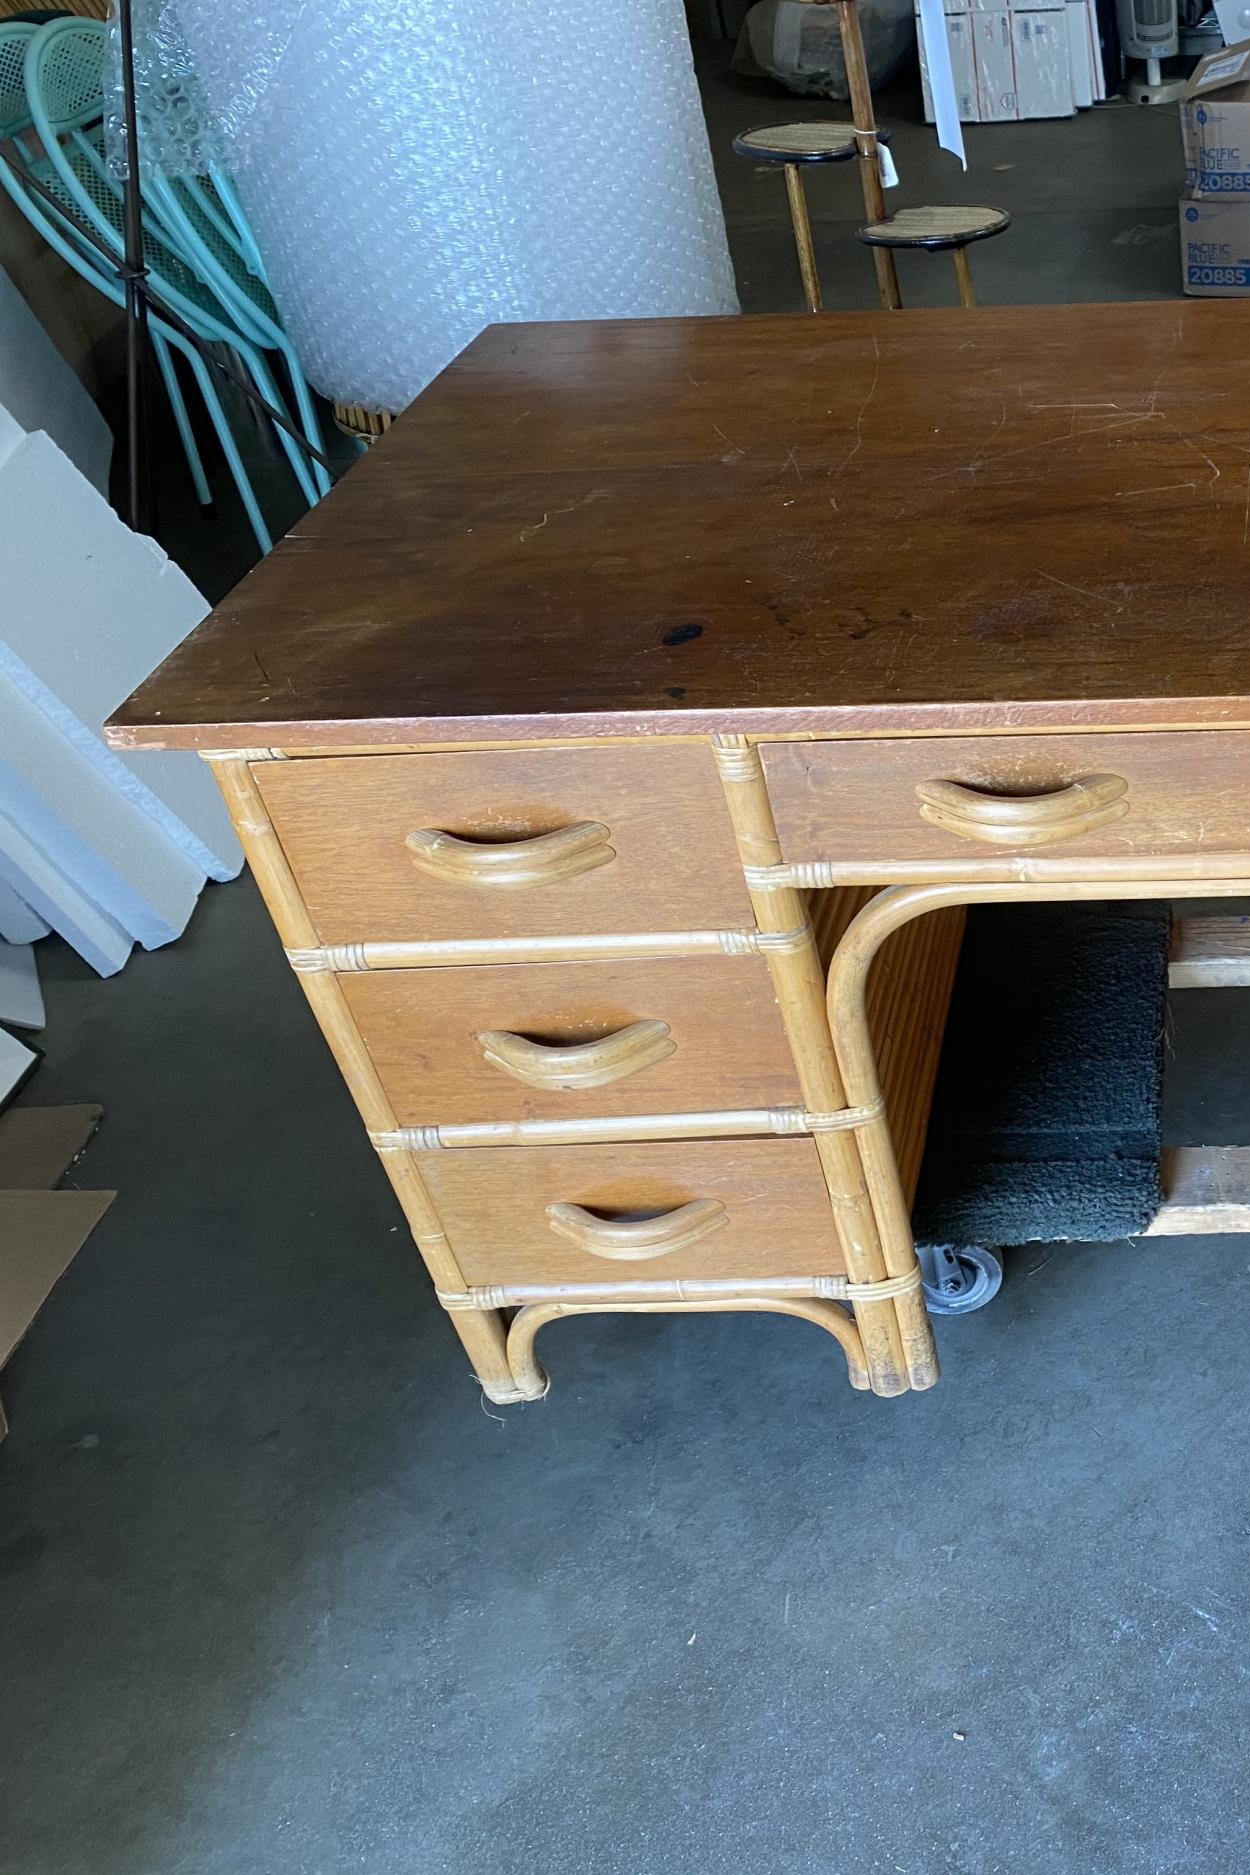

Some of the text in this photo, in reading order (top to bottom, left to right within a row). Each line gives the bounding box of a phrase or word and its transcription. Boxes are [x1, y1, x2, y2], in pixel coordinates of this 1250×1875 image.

[1187, 243, 1230, 254] PACIFIC
[1188, 254, 1214, 263] BLUE
[1190, 269, 1247, 284] 20885
